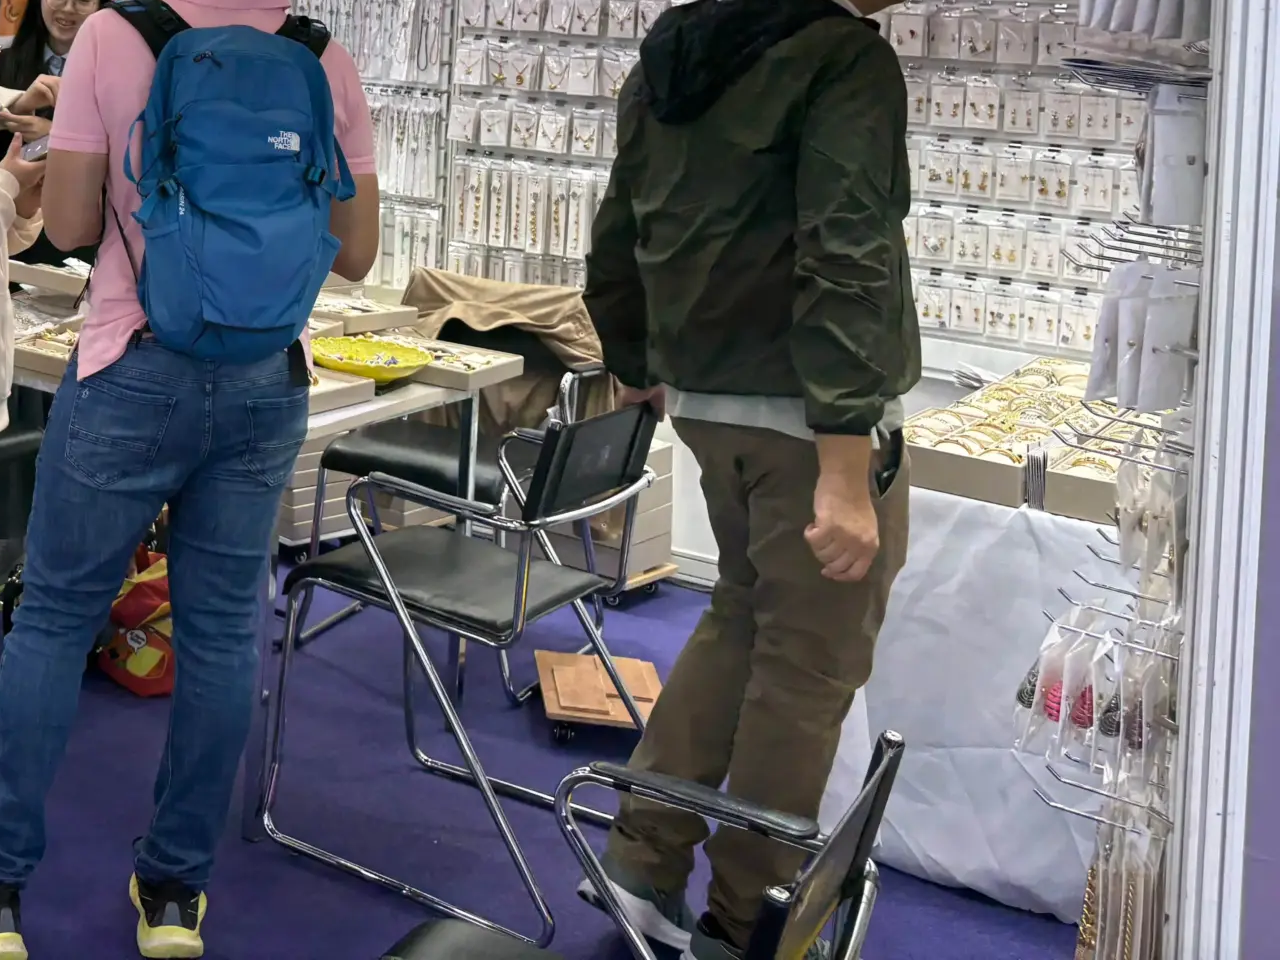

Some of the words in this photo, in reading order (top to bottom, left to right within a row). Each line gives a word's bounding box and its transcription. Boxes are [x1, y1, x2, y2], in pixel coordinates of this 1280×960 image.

[279, 130, 293, 138] THE
[267, 136, 293, 144] NORTH
[274, 143, 294, 151] FACE
